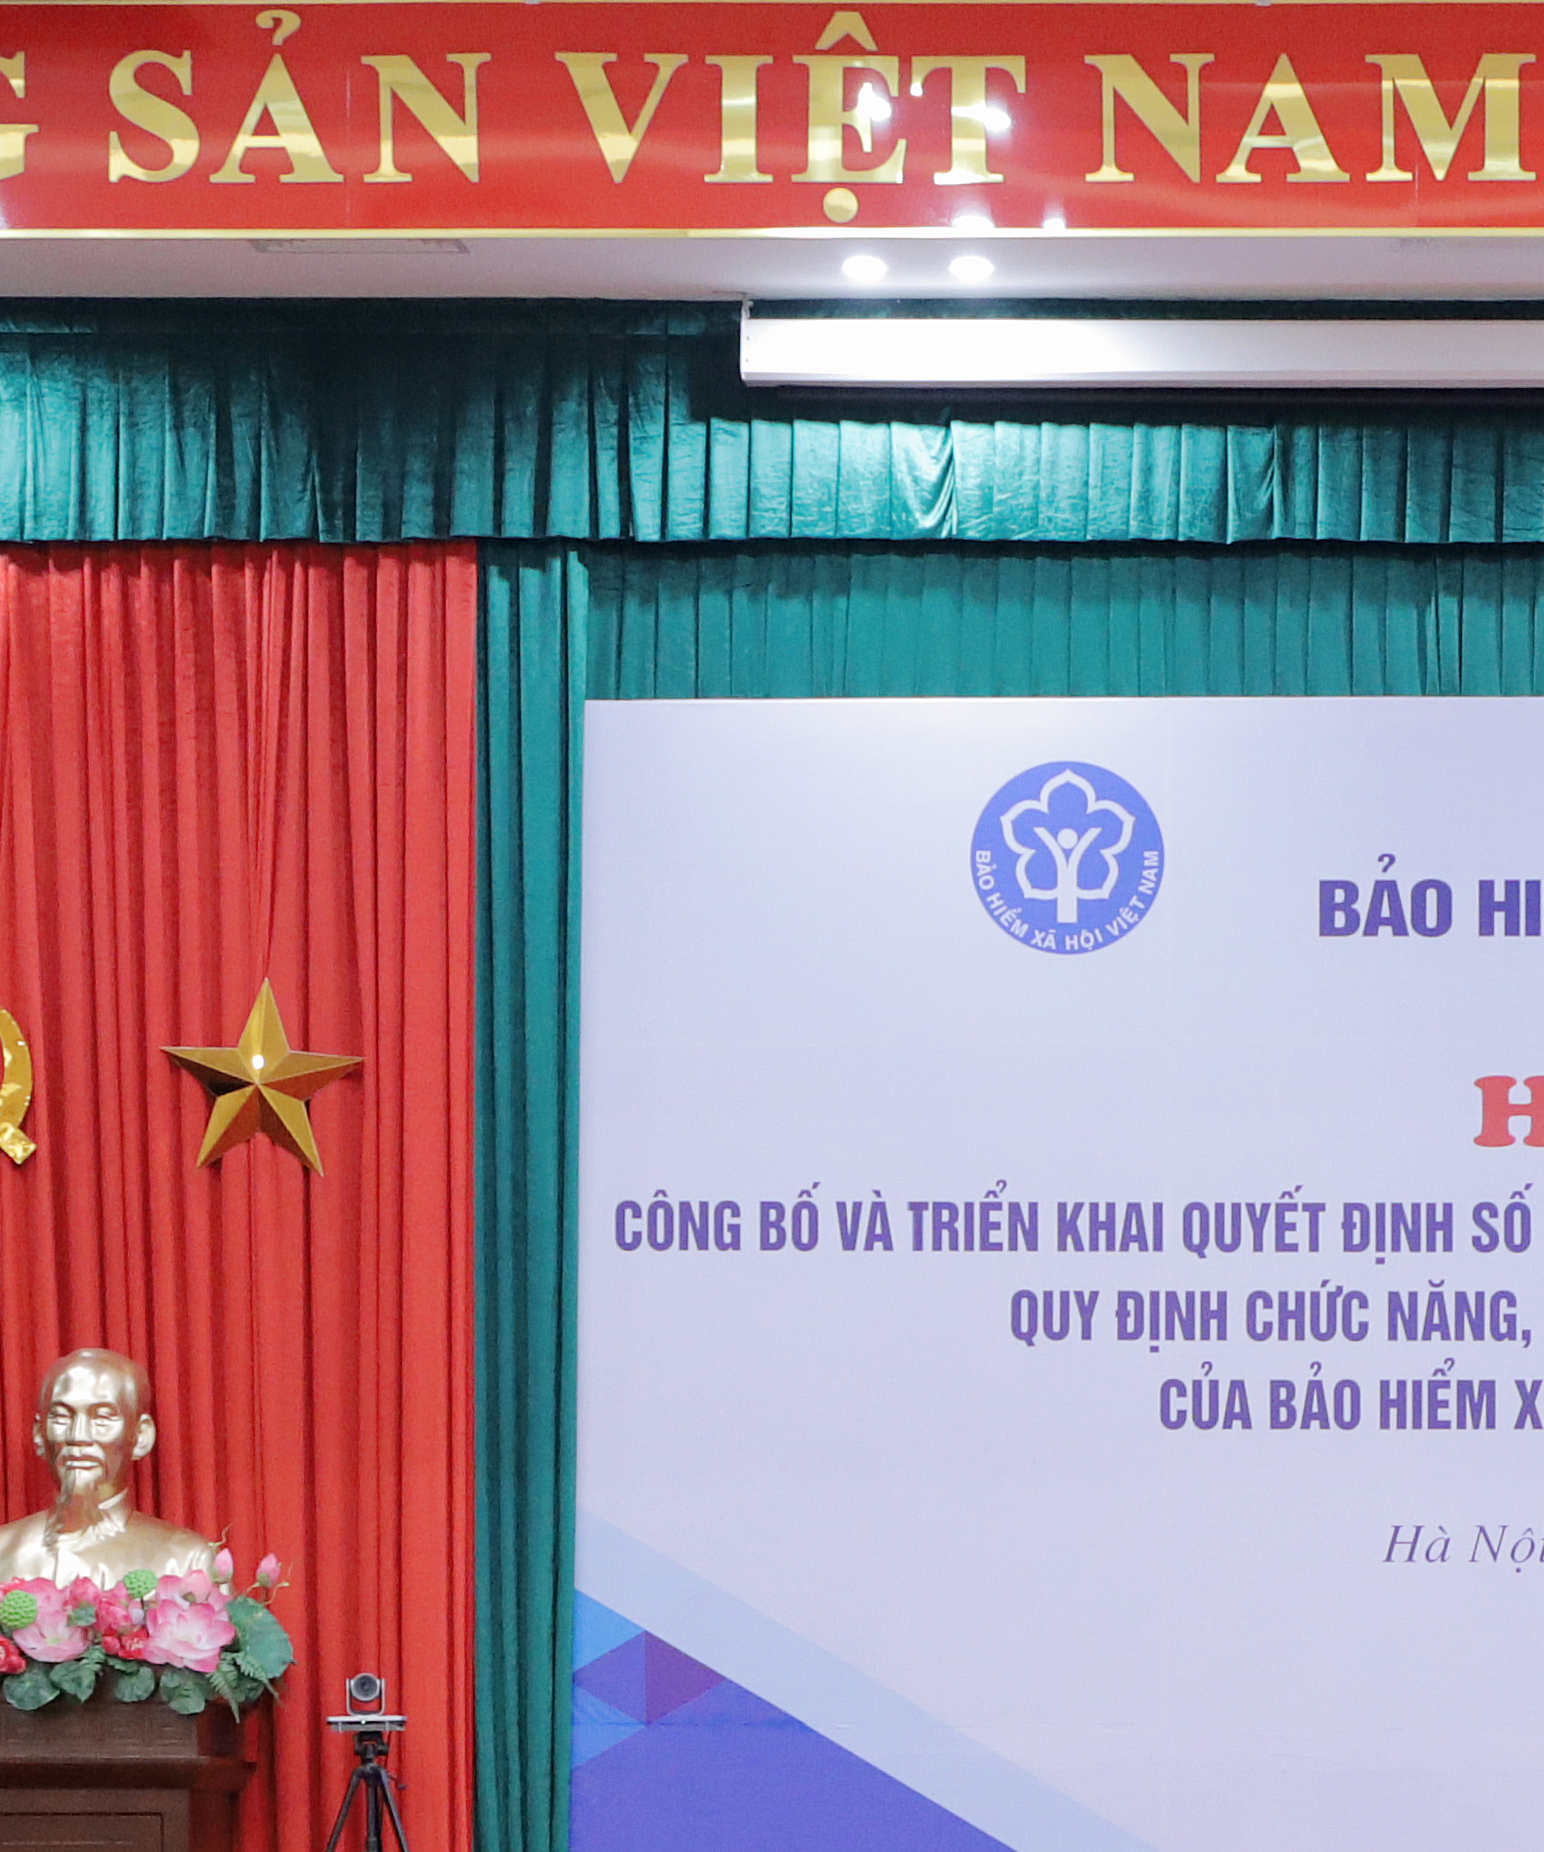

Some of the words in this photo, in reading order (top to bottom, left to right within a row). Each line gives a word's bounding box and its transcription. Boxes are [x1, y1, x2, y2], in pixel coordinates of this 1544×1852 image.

[108, 10, 491, 183] SẢN
[556, 10, 1027, 225] VIỆT
[1085, 52, 1536, 183] NAM
[976, 850, 997, 891] BẢO
[987, 892, 1029, 938] HIỂM
[1031, 929, 1056, 949] XÃ
[1066, 928, 1104, 951] HỘI
[1105, 896, 1145, 936] VIỆT
[1138, 851, 1159, 895] NAM
[1320, 856, 1452, 937] BẢO
[615, 1190, 740, 1251] CÔNG
[760, 1182, 820, 1251] BỐ
[836, 1190, 893, 1251] VÀ
[908, 1179, 1038, 1251] TRIỂN
[1058, 1202, 1163, 1252] KHAI
[1183, 1185, 1326, 1254] QUYẾT
[1341, 1203, 1453, 1264] ĐỊNH
[1472, 1183, 1532, 1253] SỐ
[1011, 1290, 1099, 1346] QUY
[1116, 1291, 1227, 1353] ĐỊNH
[1246, 1280, 1368, 1341] CHỨC
[1388, 1280, 1531, 1349] NĂNG,
[1160, 1361, 1252, 1430] CỦA
[1270, 1361, 1360, 1430] BẢO
[1380, 1358, 1496, 1429] HIỂM
[1382, 1525, 1451, 1563] Hà
